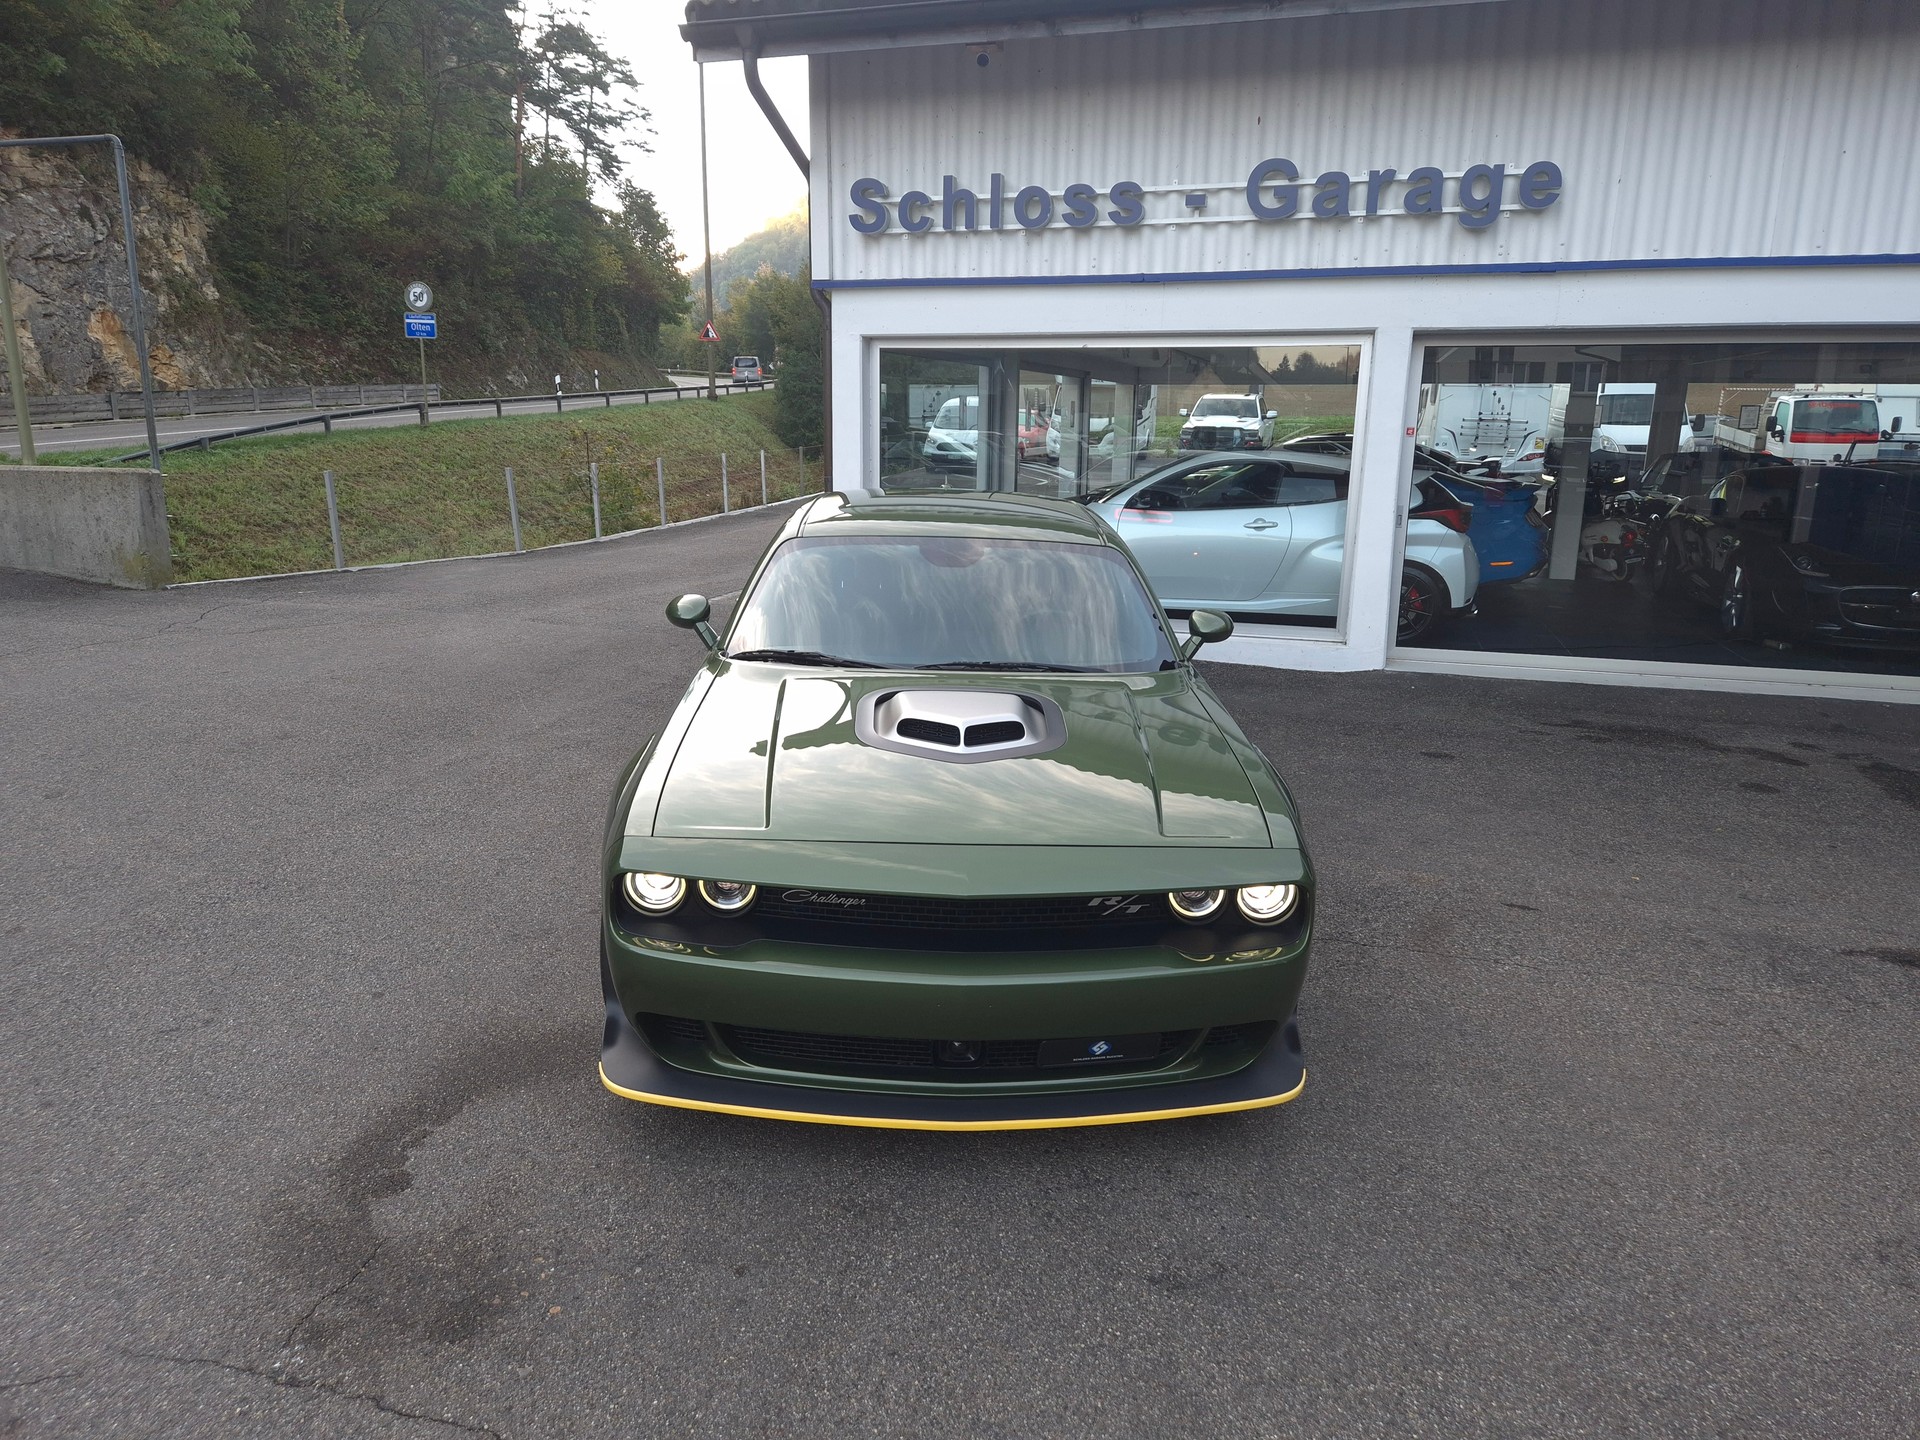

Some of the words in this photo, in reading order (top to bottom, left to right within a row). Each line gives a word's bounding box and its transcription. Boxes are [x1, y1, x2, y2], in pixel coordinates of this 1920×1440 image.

[849, 173, 1146, 234] Schloss
[1246, 157, 1563, 229] Garage
[412, 291, 424, 302] 50
[411, 322, 431, 331] Olten
[781, 889, 866, 908] Challenger
[1088, 894, 1150, 916] R/T
